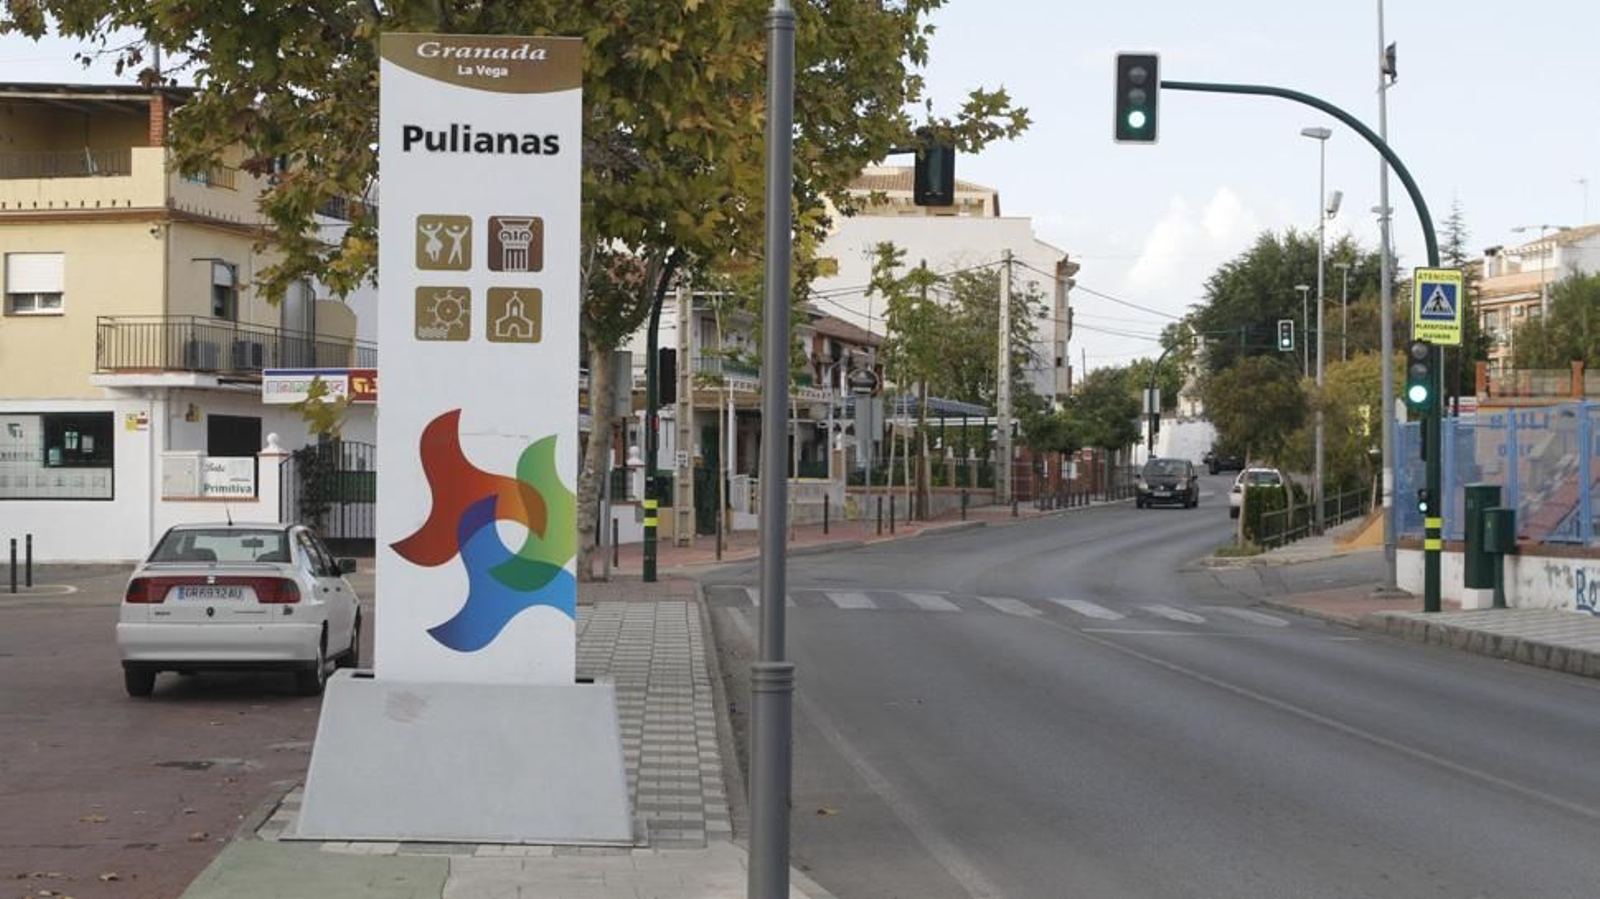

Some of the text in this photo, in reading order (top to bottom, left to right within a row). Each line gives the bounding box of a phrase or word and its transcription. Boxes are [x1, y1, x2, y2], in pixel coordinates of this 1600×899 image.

[416, 41, 548, 61] Granada
[457, 64, 509, 78] La Vega
[402, 123, 561, 156] Pulianas
[203, 483, 252, 493] Primitiva
